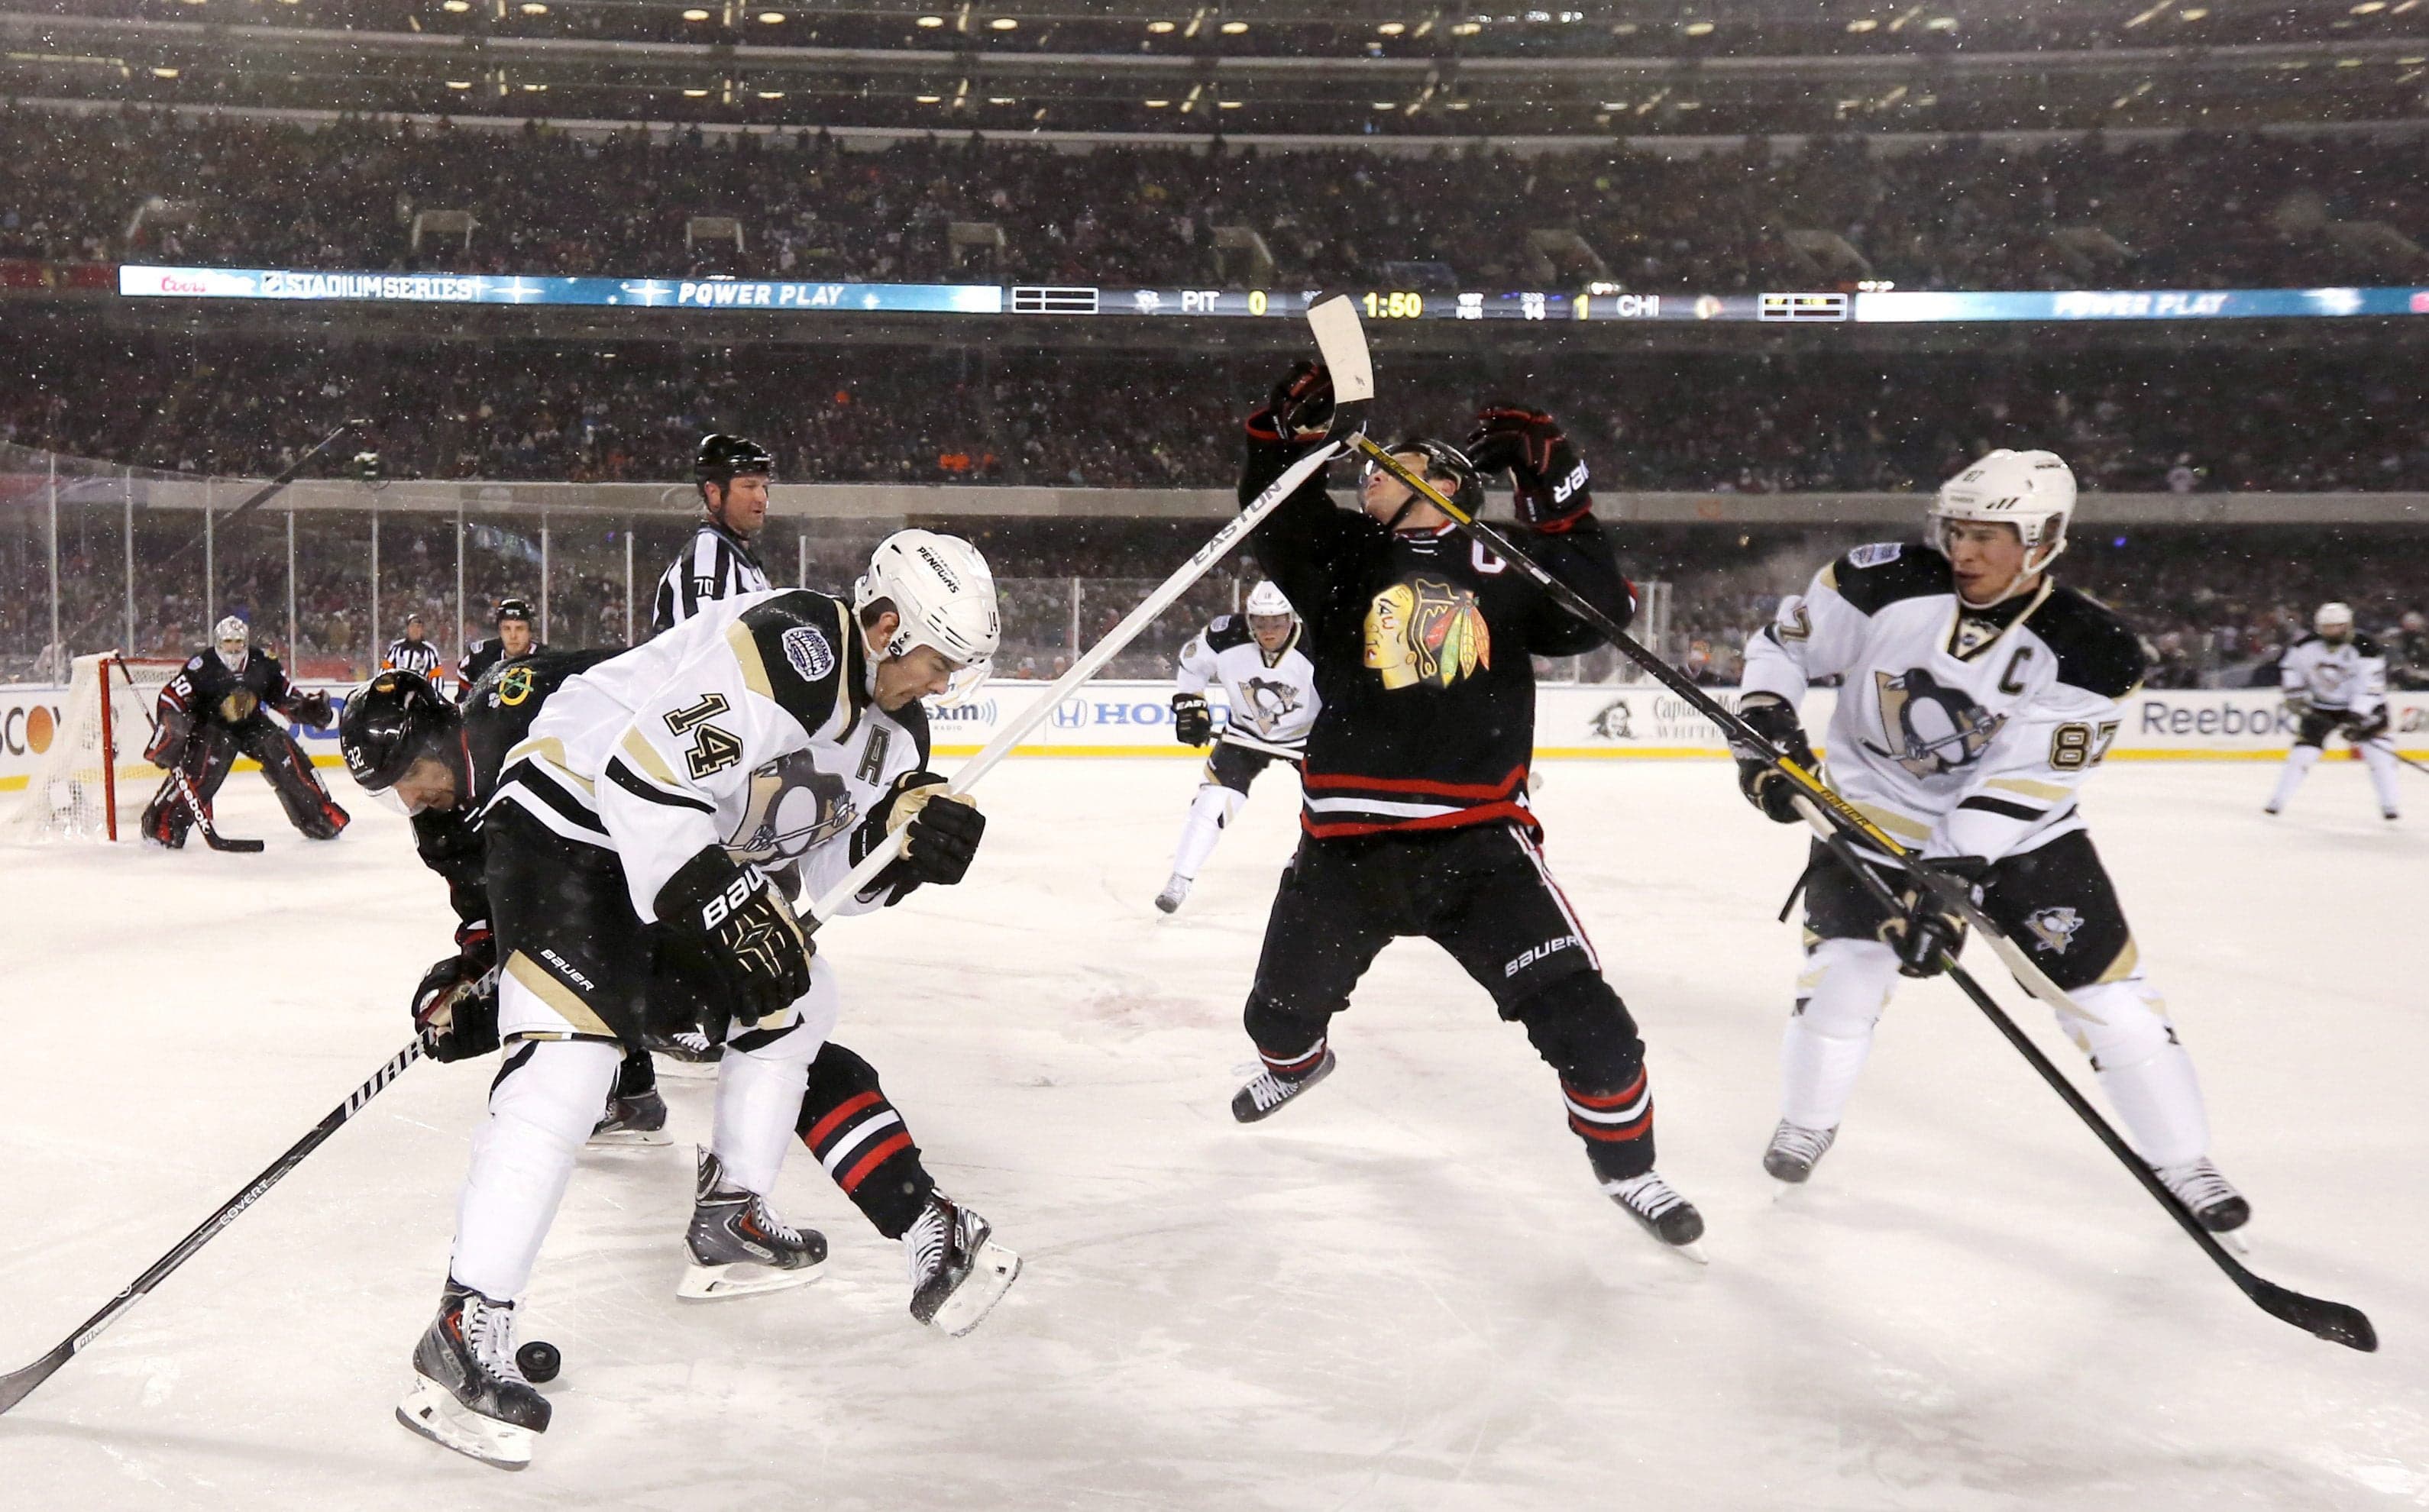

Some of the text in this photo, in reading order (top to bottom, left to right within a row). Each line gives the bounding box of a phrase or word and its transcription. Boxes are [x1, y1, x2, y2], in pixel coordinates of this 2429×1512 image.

[678, 283, 844, 305] POWER PLAY
[1182, 290, 1267, 316] PIT 0
[1362, 292, 1423, 318] 1:50
[1573, 293, 1660, 320] 1 CHI
[2156, 292, 2229, 315] PLAY
[1192, 480, 1282, 567] EASTON
[694, 578, 715, 596] 70
[917, 545, 960, 594] PENGUINS
[170, 674, 193, 697] 50
[1997, 646, 2034, 696] C
[663, 693, 744, 780] 14
[2141, 701, 2298, 735] Reebok
[348, 746, 365, 770] 32
[855, 724, 893, 788] A
[2049, 719, 2121, 772] 87
[173, 766, 211, 835] Reebok
[540, 948, 596, 992] BAUER
[1505, 935, 1580, 978] BAUER
[219, 1179, 268, 1225] COVERT
